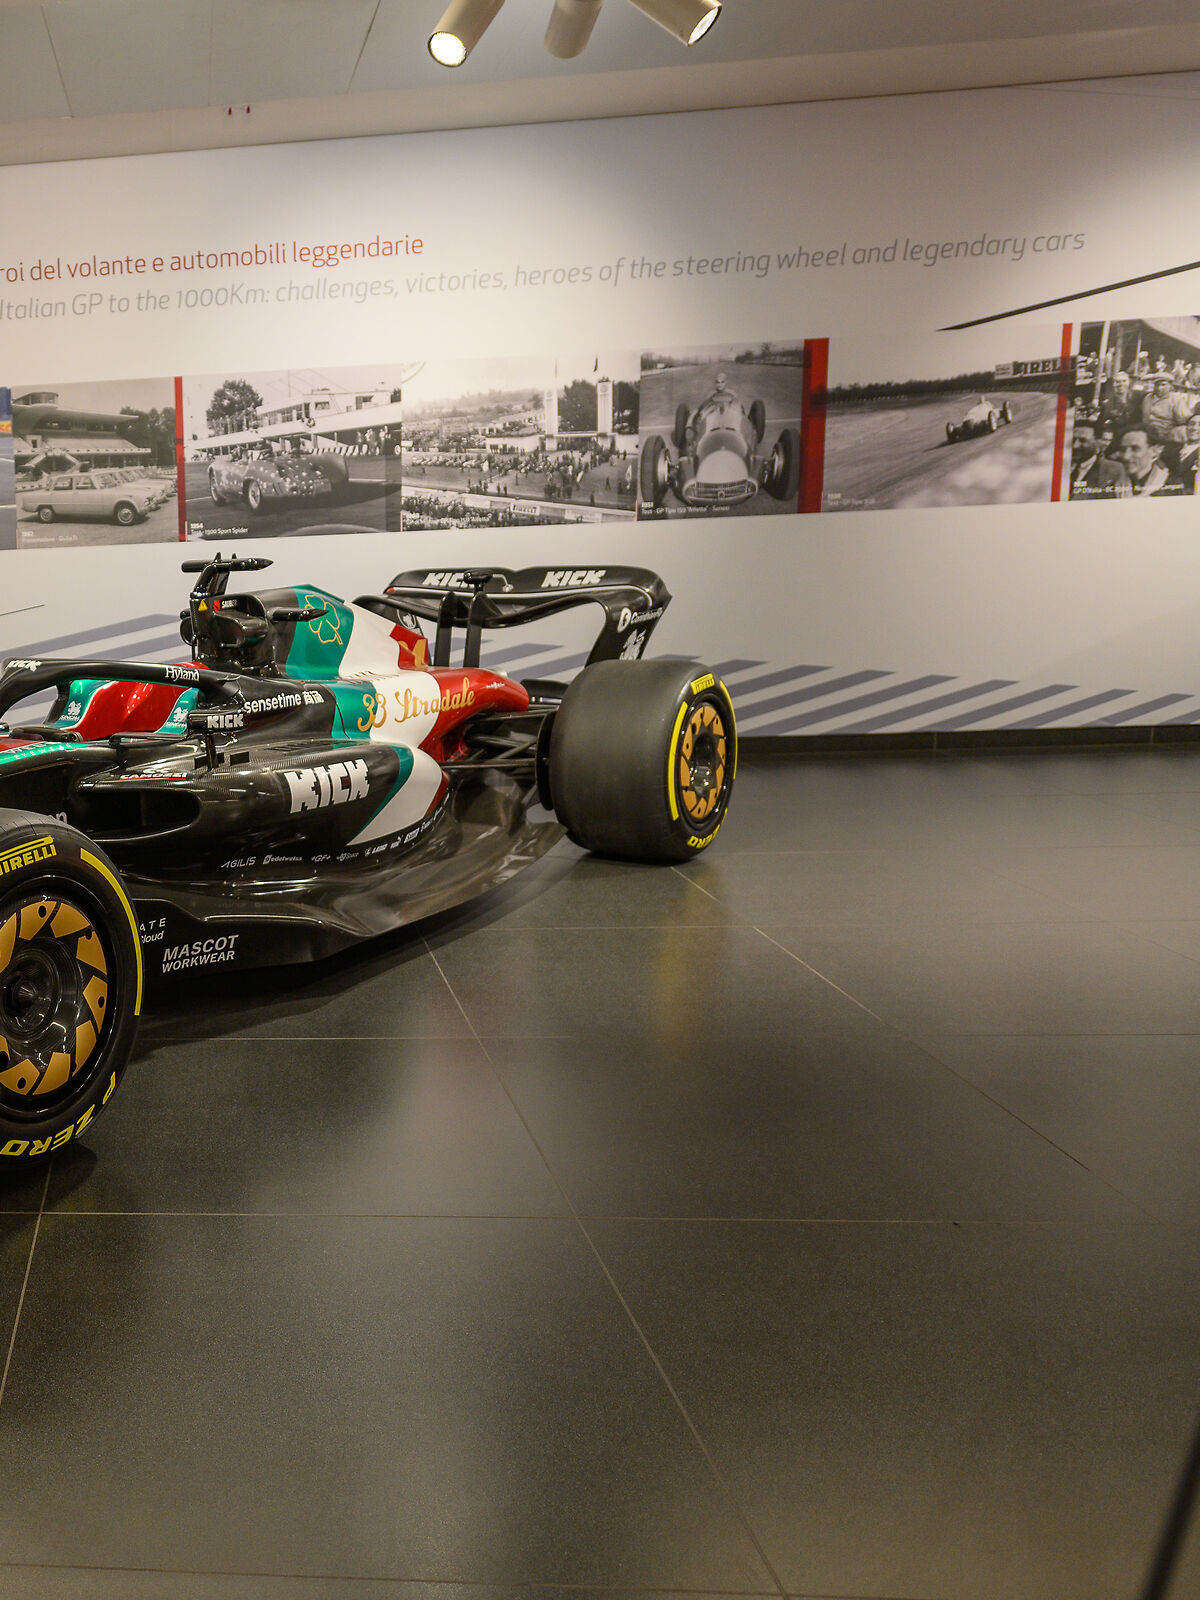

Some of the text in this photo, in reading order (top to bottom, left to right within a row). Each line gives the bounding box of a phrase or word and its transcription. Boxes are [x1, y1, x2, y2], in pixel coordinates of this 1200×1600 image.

[29, 257, 62, 282] del
[67, 254, 147, 279] volante
[152, 253, 165, 273] e
[169, 242, 287, 271] automobili
[292, 234, 424, 268] leggendarie
[0, 295, 66, 321] Italian
[71, 292, 104, 316] GP
[108, 293, 131, 314] to
[136, 288, 170, 312] the
[275, 275, 400, 306] challenges,
[405, 268, 509, 296] victories,
[514, 264, 593, 288] heroes
[599, 256, 627, 287] of
[629, 255, 667, 280] the
[672, 249, 771, 279] steering
[777, 242, 847, 270] wheel
[852, 238, 897, 266] and
[902, 233, 1027, 268] legendary
[1031, 231, 1087, 254] cars
[541, 570, 606, 588] KICK
[165, 666, 199, 682] Hyland
[244, 693, 302, 714] sensetime
[357, 677, 475, 732] 33 Stradale
[207, 714, 244, 729] KICK
[284, 758, 370, 815] KICK
[162, 950, 236, 974] WORKWEAR
[163, 934, 239, 963] MASCOT
[0, 1104, 96, 1156] ZERO
